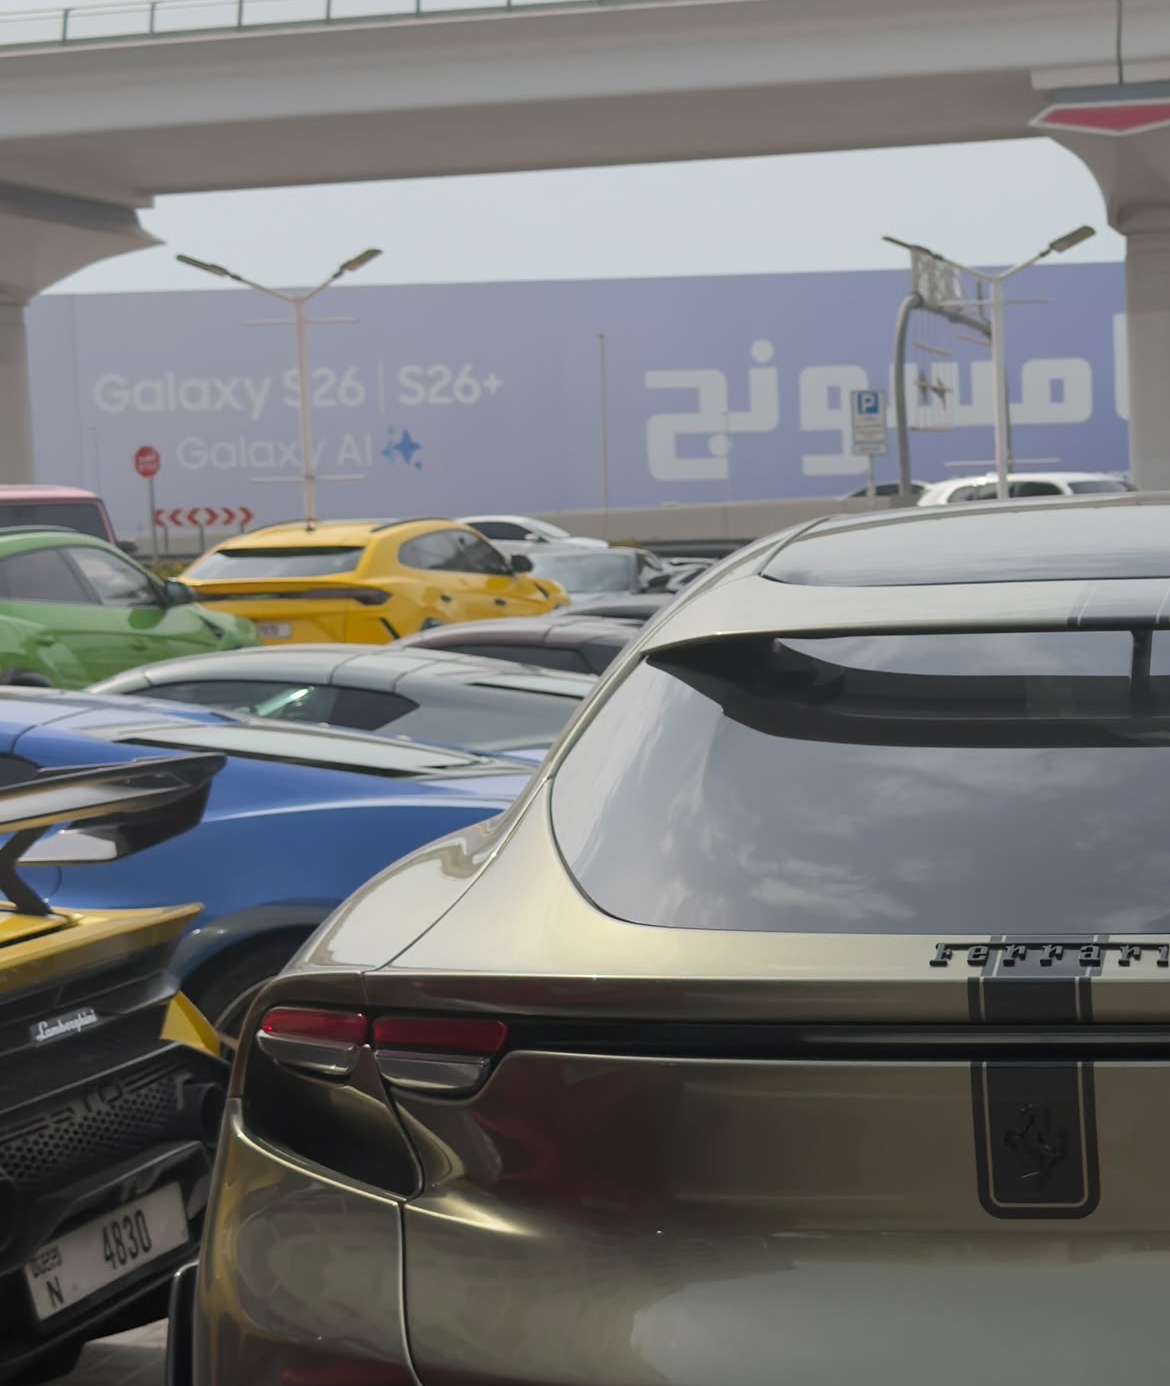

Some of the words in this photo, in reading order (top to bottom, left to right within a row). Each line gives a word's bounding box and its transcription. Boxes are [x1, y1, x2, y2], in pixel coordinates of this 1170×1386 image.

[93, 371, 272, 422] Galaxy
[282, 366, 366, 409] S26
[399, 363, 503, 406] S26+
[862, 393, 877, 414] P
[337, 432, 373, 468] AI
[929, 942, 1170, 967] Ferrari
[36, 1008, 97, 1041] Lamborghini
[102, 1210, 153, 1271] 4830
[46, 1276, 64, 1309] N
